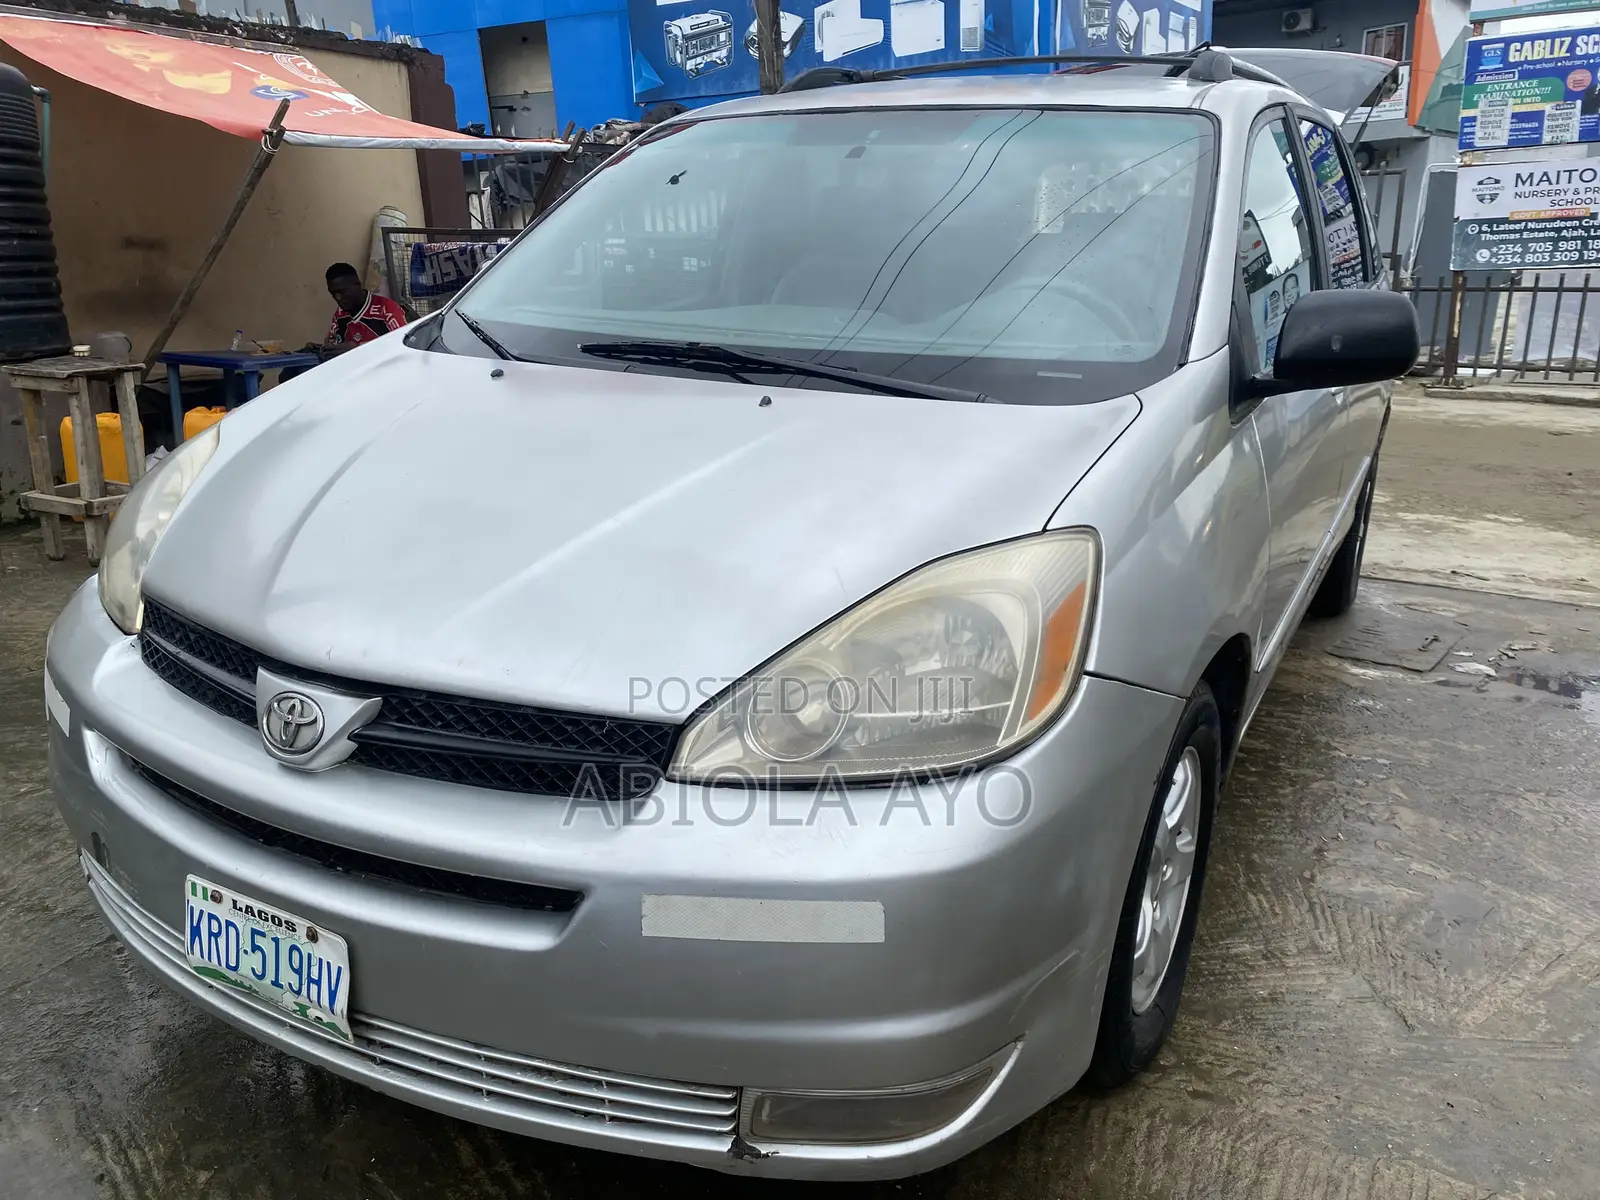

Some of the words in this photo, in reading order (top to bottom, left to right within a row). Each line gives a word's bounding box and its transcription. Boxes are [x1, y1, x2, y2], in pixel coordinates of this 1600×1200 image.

[1484, 50, 1502, 58] GLS
[1508, 36, 1572, 63] GABLIZ
[1575, 34, 1600, 56] SC
[1562, 59, 1588, 68] Nursery
[1476, 73, 1514, 82] Admission
[1487, 79, 1539, 92] ENTRANCE
[1473, 86, 1552, 101] EXAMINATION!!!
[1514, 167, 1597, 188] MAITO
[1514, 188, 1570, 199] NURSERY
[1573, 187, 1581, 196] &
[1585, 186, 1600, 195] PR
[1550, 196, 1600, 208] SCHOOL
[1539, 208, 1586, 218] APPROVED
[1481, 223, 1491, 232] 6,
[1493, 221, 1527, 231] Lateef
[1527, 219, 1580, 229] Nurudeen
[1480, 233, 1521, 241] Thomas
[1522, 231, 1558, 240] Estate,
[1560, 228, 1588, 239] Ajah,
[1490, 243, 1523, 254] +234
[1528, 242, 1554, 252] 705
[1558, 240, 1582, 250] 981
[1490, 254, 1522, 264] +234
[1525, 252, 1551, 263] 803
[1553, 251, 1580, 261] 309
[231, 898, 298, 933] LAGOS
[262, 921, 302, 941] EXCELLENCE
